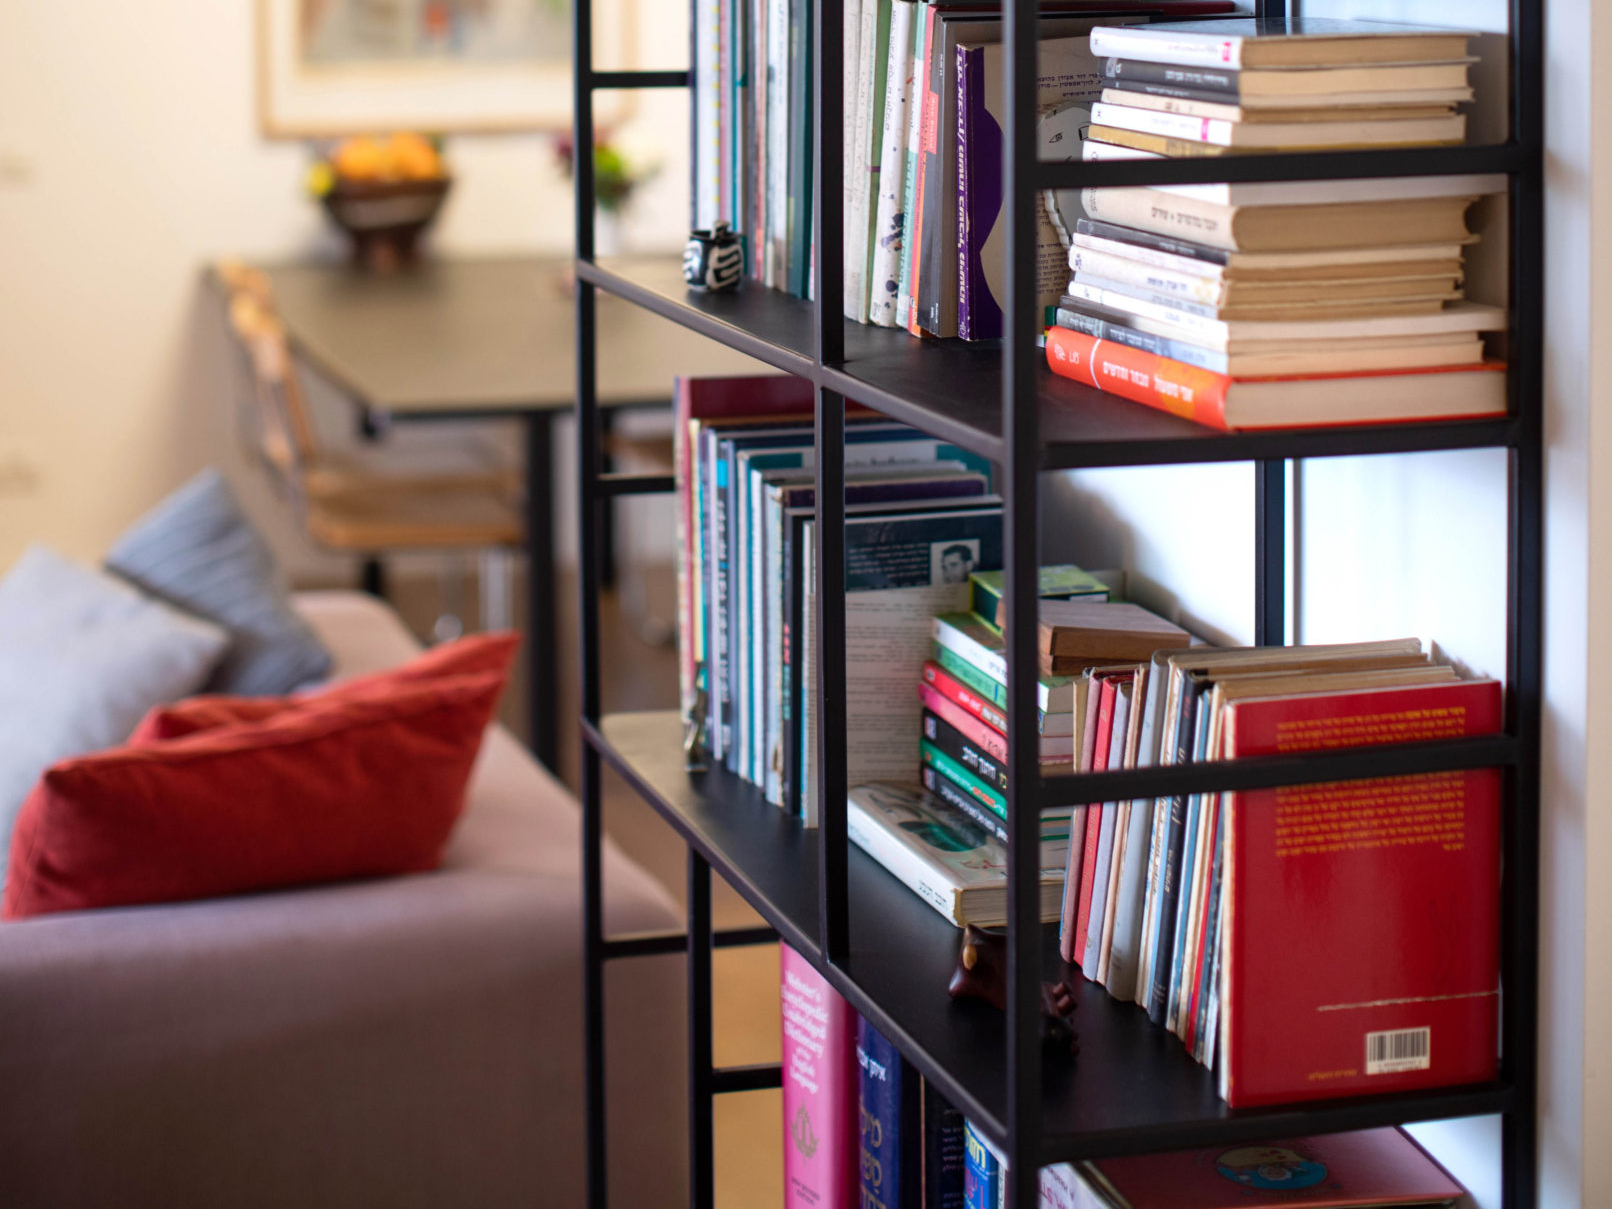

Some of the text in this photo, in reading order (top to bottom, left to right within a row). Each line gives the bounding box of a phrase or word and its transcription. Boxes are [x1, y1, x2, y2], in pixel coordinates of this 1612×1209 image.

[956, 55, 967, 87] דוד
[957, 145, 967, 192] משהו
[957, 195, 968, 250] בשביל
[957, 253, 968, 306] מישהו
